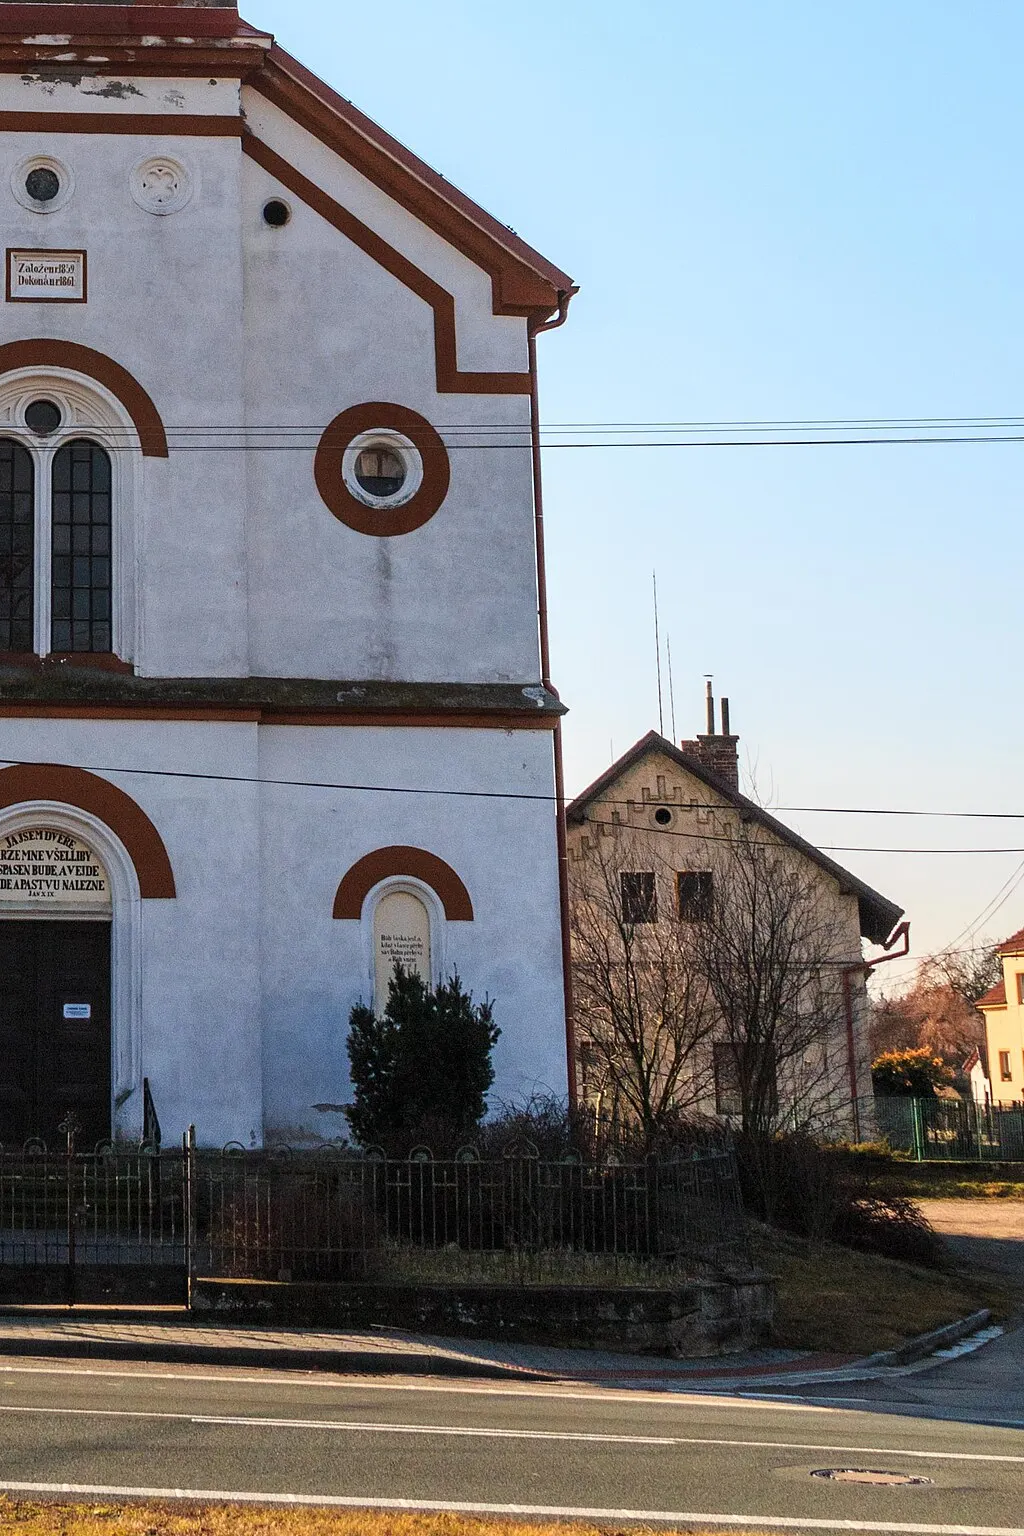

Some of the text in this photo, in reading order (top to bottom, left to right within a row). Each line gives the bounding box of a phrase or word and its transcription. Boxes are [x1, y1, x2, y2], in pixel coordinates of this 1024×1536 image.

[19, 830, 44, 843] JSEM
[22, 850, 44, 861] MNE
[59, 866, 67, 876] A
[67, 866, 99, 877] VEJDE
[13, 879, 20, 890] A
[20, 879, 60, 891] PASTVU
[62, 880, 105, 891] NALEZNE
